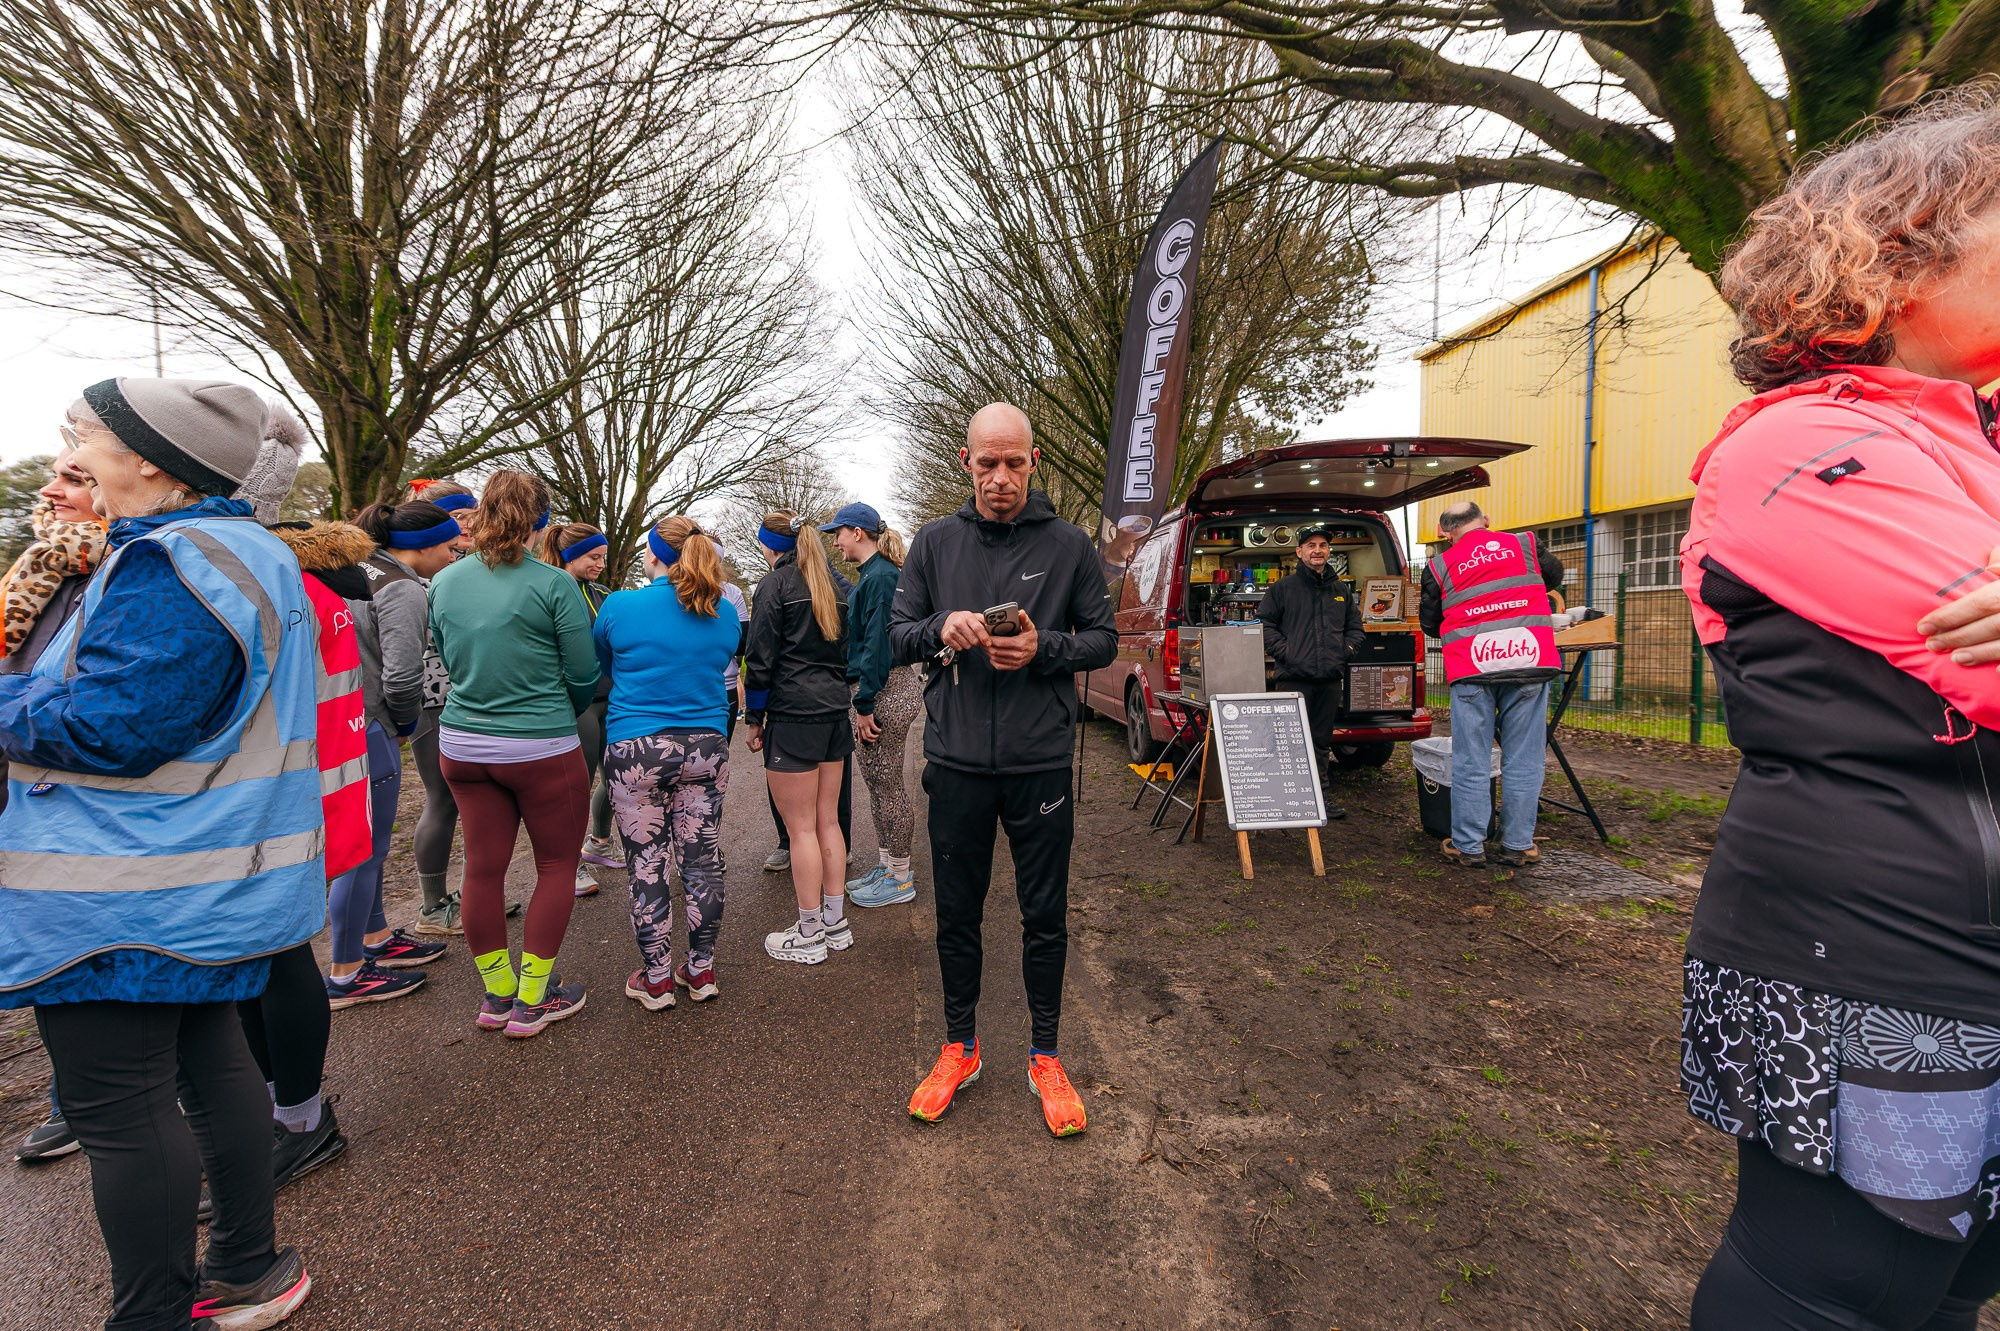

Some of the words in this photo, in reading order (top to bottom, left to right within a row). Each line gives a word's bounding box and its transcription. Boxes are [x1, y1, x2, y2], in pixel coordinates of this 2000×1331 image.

[1124, 218, 1196, 502] COFFEE
[1458, 547, 1515, 575] parkrun
[1465, 600, 1528, 616] VOLUNTEER
[1474, 639, 1536, 663] Vitality
[1241, 706, 1272, 714] COFFEE
[1274, 705, 1296, 714] MENU
